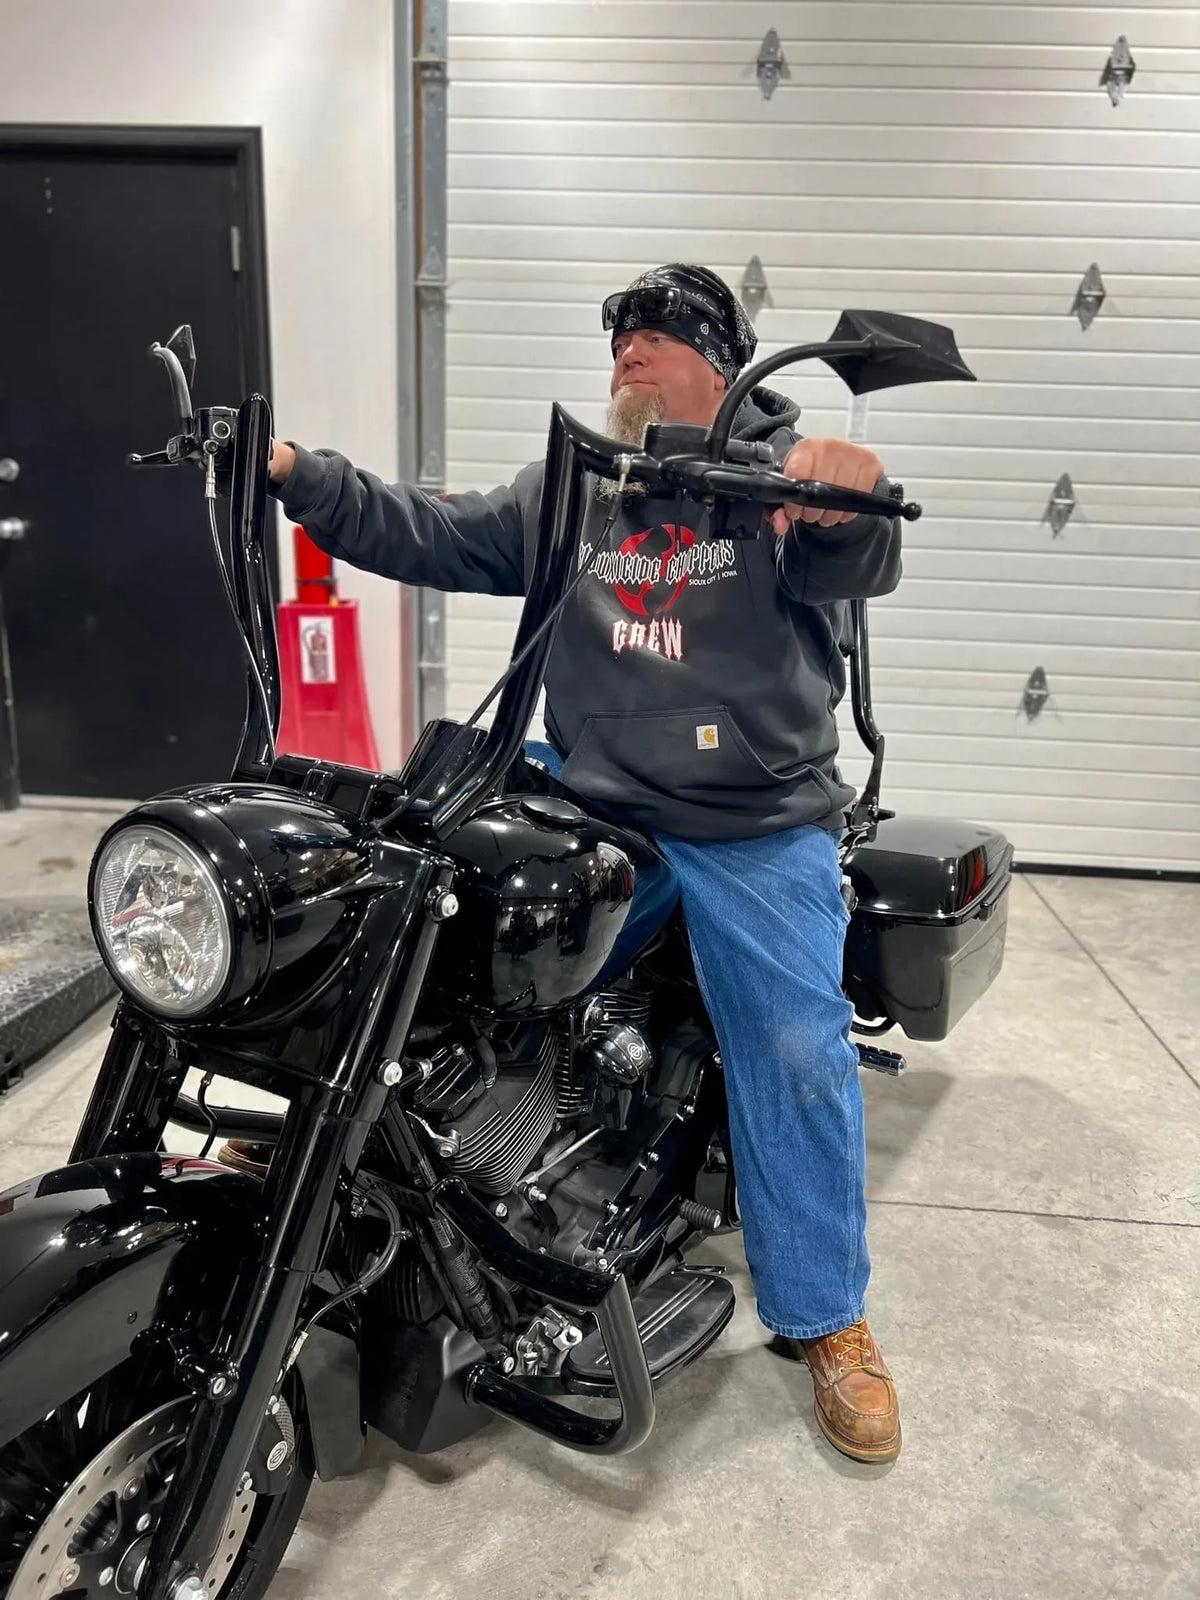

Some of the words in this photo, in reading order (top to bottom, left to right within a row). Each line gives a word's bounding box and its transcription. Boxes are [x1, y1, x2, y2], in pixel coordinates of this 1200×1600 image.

[689, 577, 706, 586] SIOUX
[707, 575, 716, 584] CITY
[722, 570, 738, 579] IOWA
[612, 617, 683, 662] CREW
